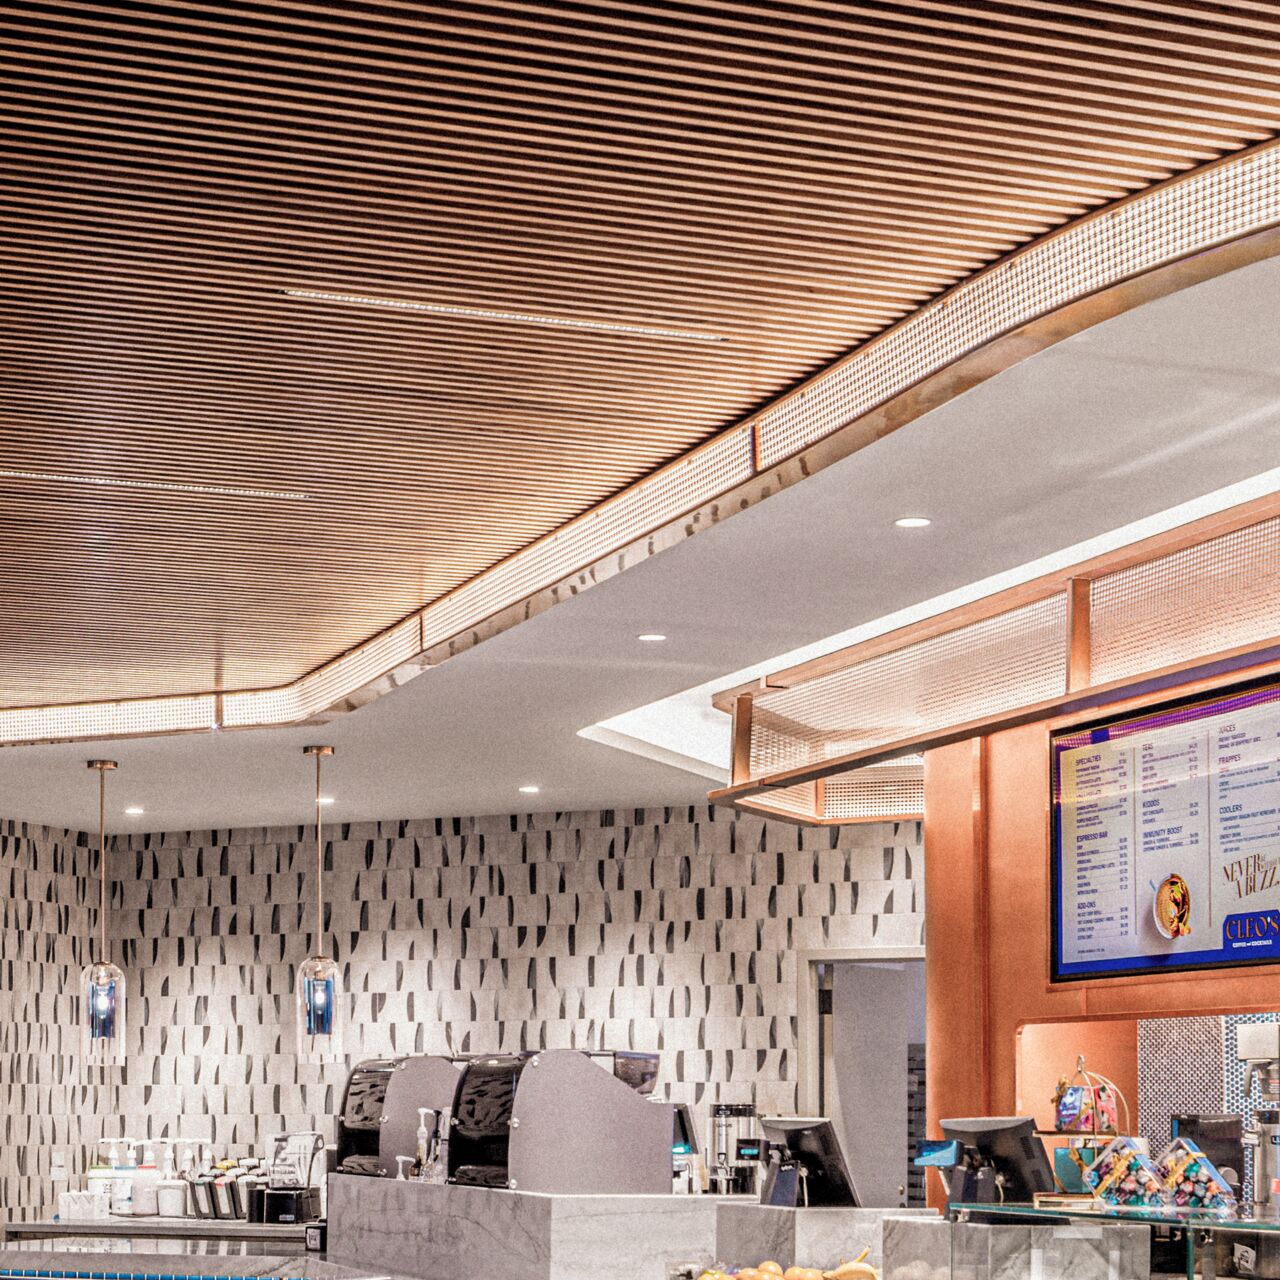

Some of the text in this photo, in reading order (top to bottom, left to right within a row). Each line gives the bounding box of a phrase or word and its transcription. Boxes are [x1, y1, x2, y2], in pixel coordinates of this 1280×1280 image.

[1219, 804, 1243, 815] COOLERS
[1167, 825, 1183, 836] BOOST
[1077, 831, 1108, 842] ESPRESSO BAR
[1223, 853, 1261, 882] NEVER
[1225, 914, 1280, 940] CLEO'S
